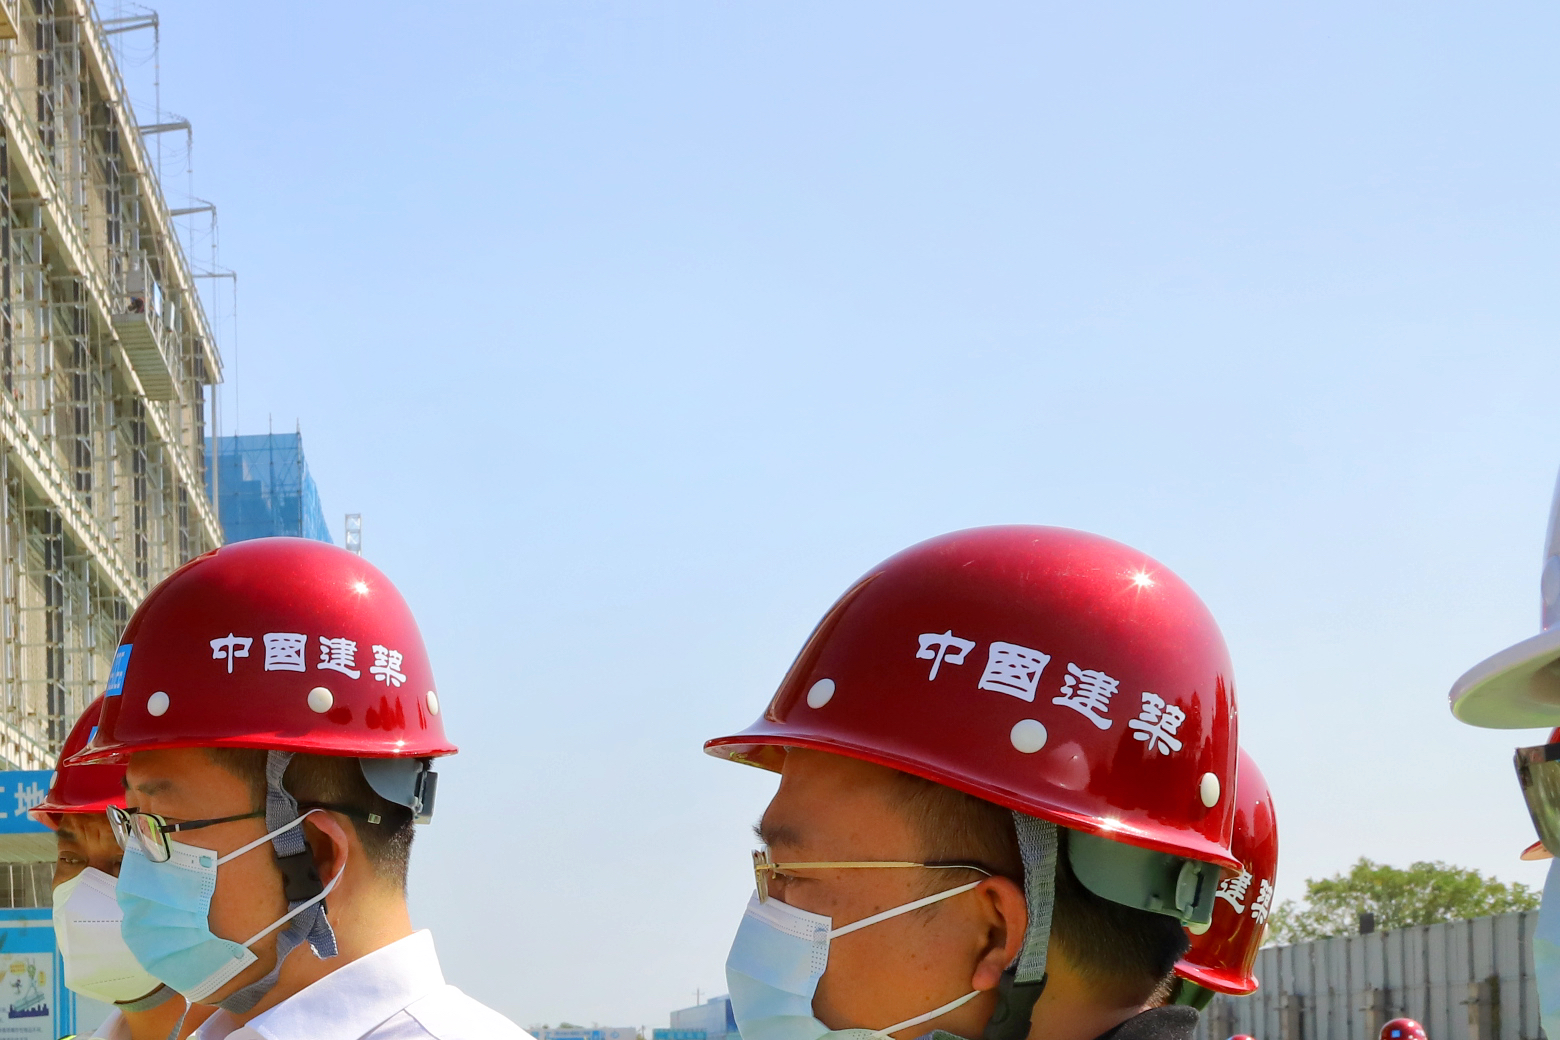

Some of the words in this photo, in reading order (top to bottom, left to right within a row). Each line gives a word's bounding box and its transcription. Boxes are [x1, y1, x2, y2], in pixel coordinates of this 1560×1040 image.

[209, 632, 407, 687] 中國建築
[915, 629, 1187, 756] 中國建築
